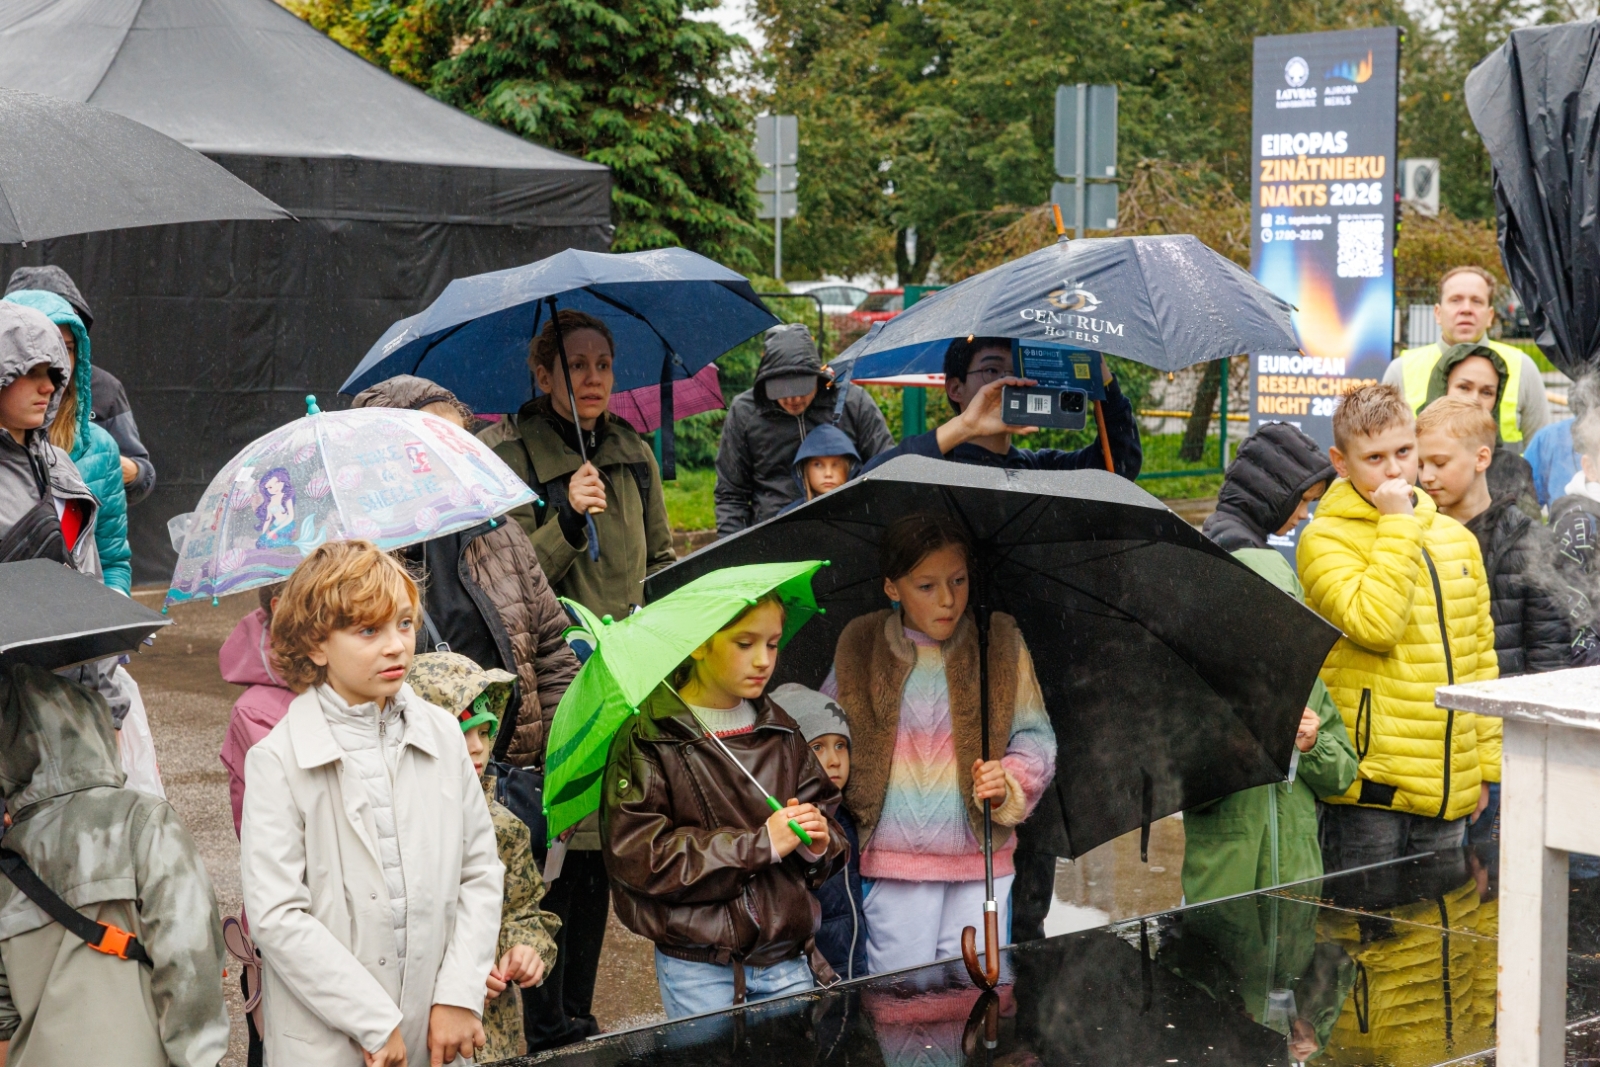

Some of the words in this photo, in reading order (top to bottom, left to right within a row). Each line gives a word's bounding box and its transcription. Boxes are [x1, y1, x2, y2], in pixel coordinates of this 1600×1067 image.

[1276, 87, 1317, 101] LATVIJAS
[1261, 131, 1348, 156] EIROPAS
[1260, 154, 1385, 182] ZINĀTNIEKU
[1260, 184, 1327, 207] NAKTS
[1330, 182, 1383, 206] 2026
[1020, 308, 1124, 337] CENTRUM
[1044, 326, 1099, 344] HOTELS
[1258, 355, 1345, 375] EUROPEAN
[1257, 396, 1310, 415] NIGHT
[1311, 397, 1341, 416] 20
